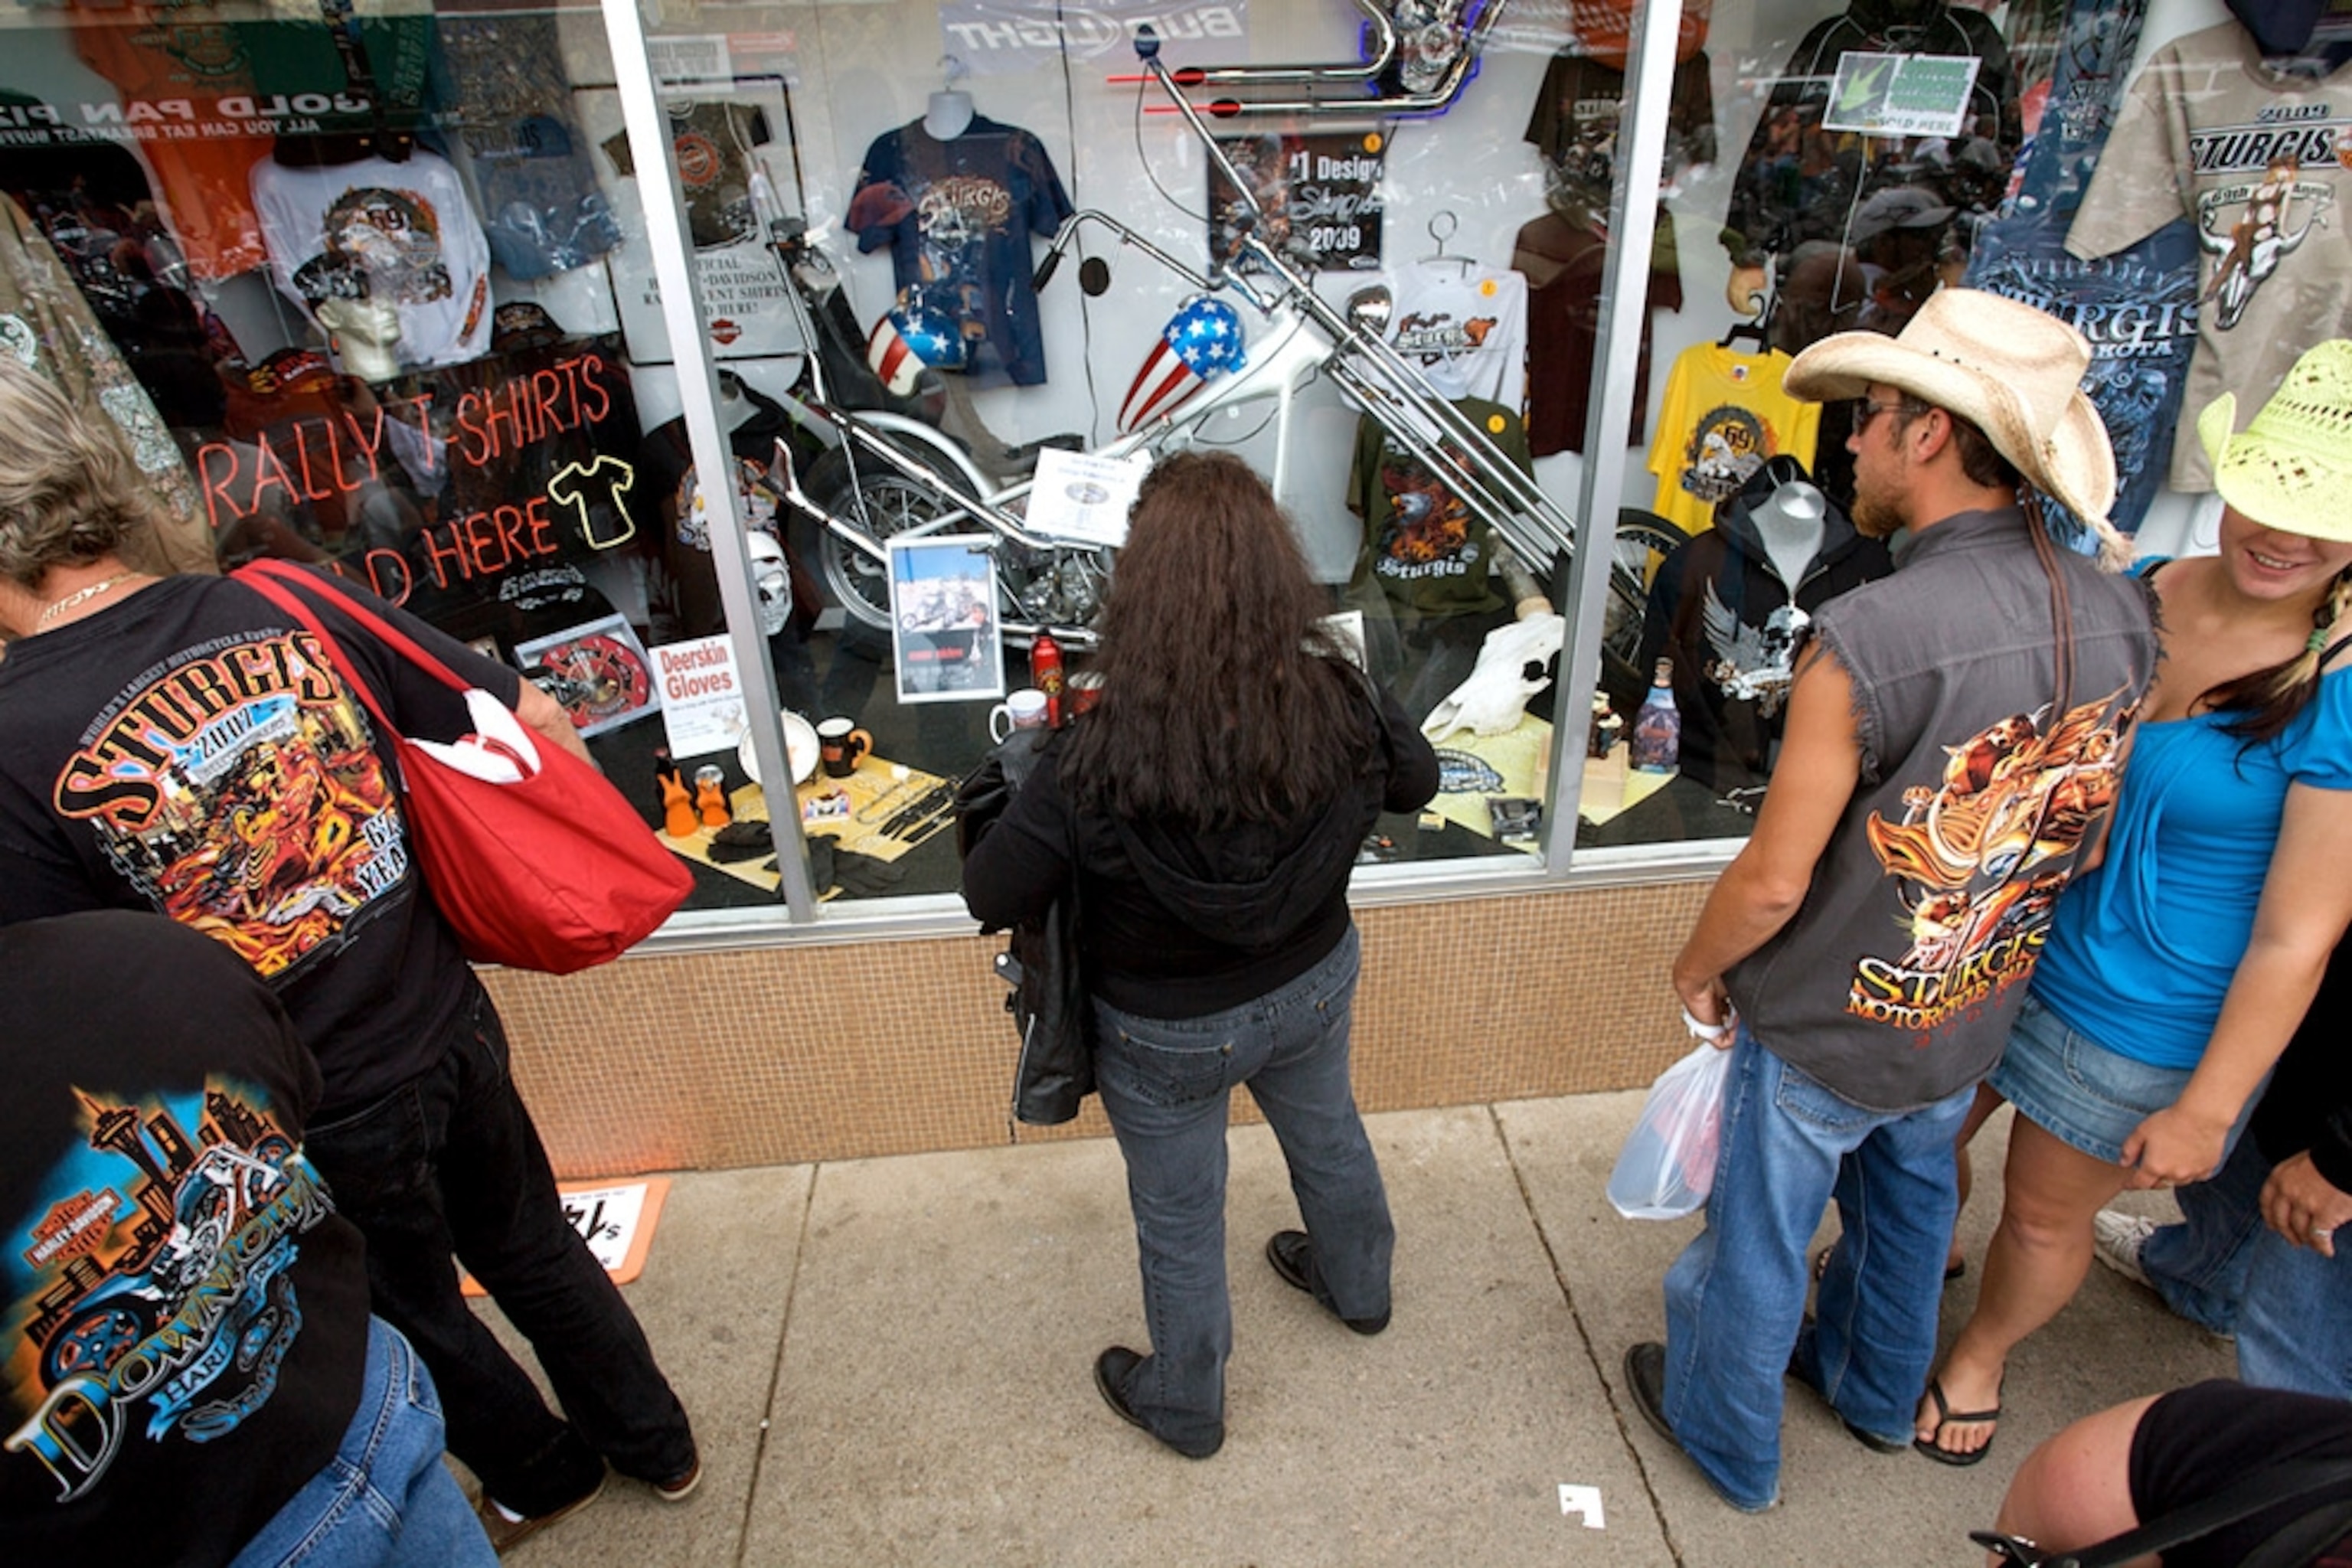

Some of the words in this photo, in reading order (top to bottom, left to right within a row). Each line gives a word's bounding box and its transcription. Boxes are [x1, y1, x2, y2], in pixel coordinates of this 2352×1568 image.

[2256, 103, 2330, 120] 2009
[2190, 127, 2336, 171] STURGIS
[1310, 225, 1361, 251] 2009
[198, 405, 383, 527] RALLY
[411, 354, 610, 469] T-SHIRTS
[1724, 426, 1749, 449] 69
[421, 495, 557, 589] HERE
[1377, 554, 1466, 579] Sturgis
[659, 641, 730, 675] Deerskin
[666, 671, 733, 700] Gloves
[54, 629, 339, 831] STURGIS
[194, 707, 253, 761] 2007
[1854, 924, 2052, 1008] STURGIS
